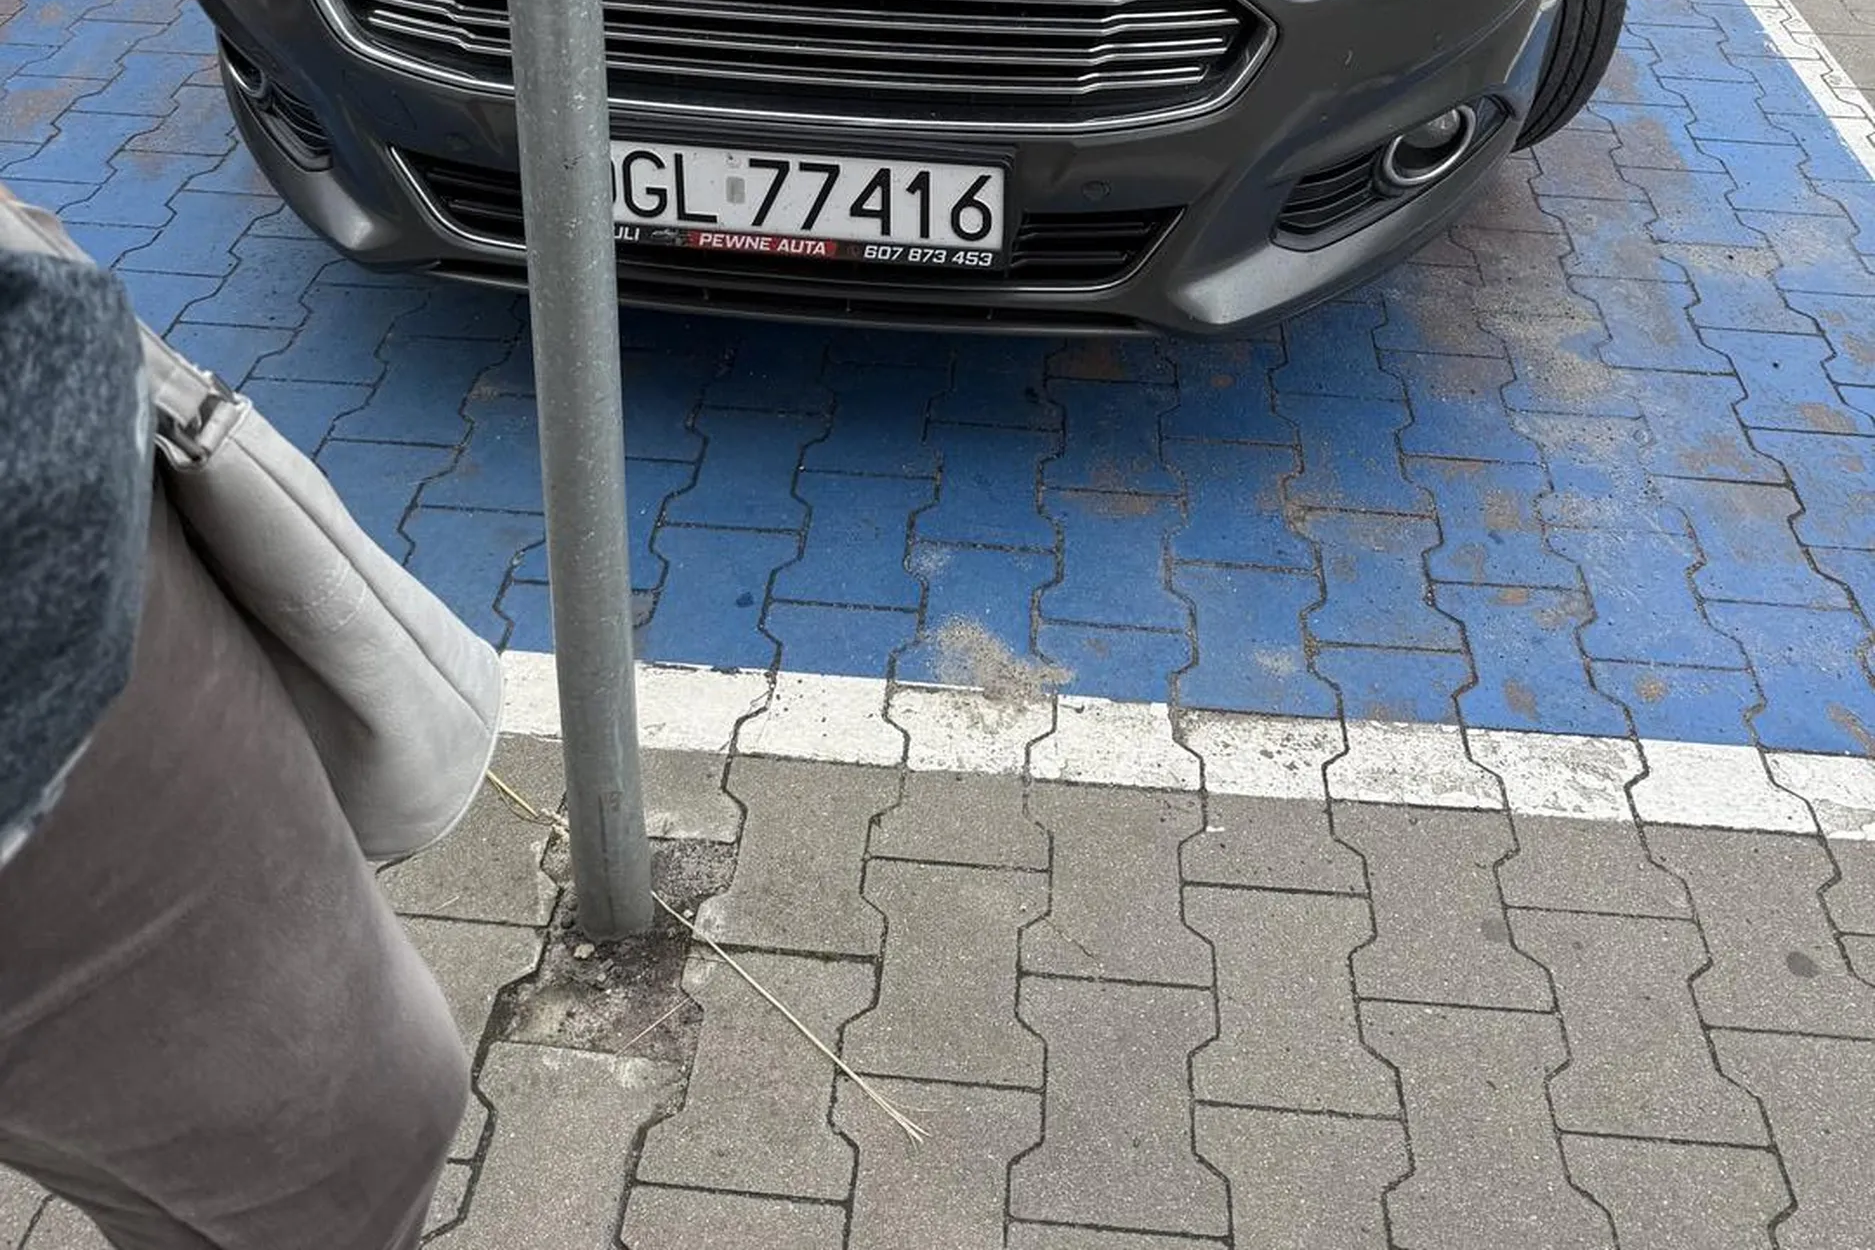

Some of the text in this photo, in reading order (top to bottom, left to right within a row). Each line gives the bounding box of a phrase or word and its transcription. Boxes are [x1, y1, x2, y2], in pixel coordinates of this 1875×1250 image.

[611, 150, 992, 242] GL 77416
[699, 233, 772, 250] PEWNE
[777, 239, 826, 255] AUTA
[864, 245, 903, 260] 607
[908, 248, 947, 263] 873
[952, 251, 993, 266] 453
